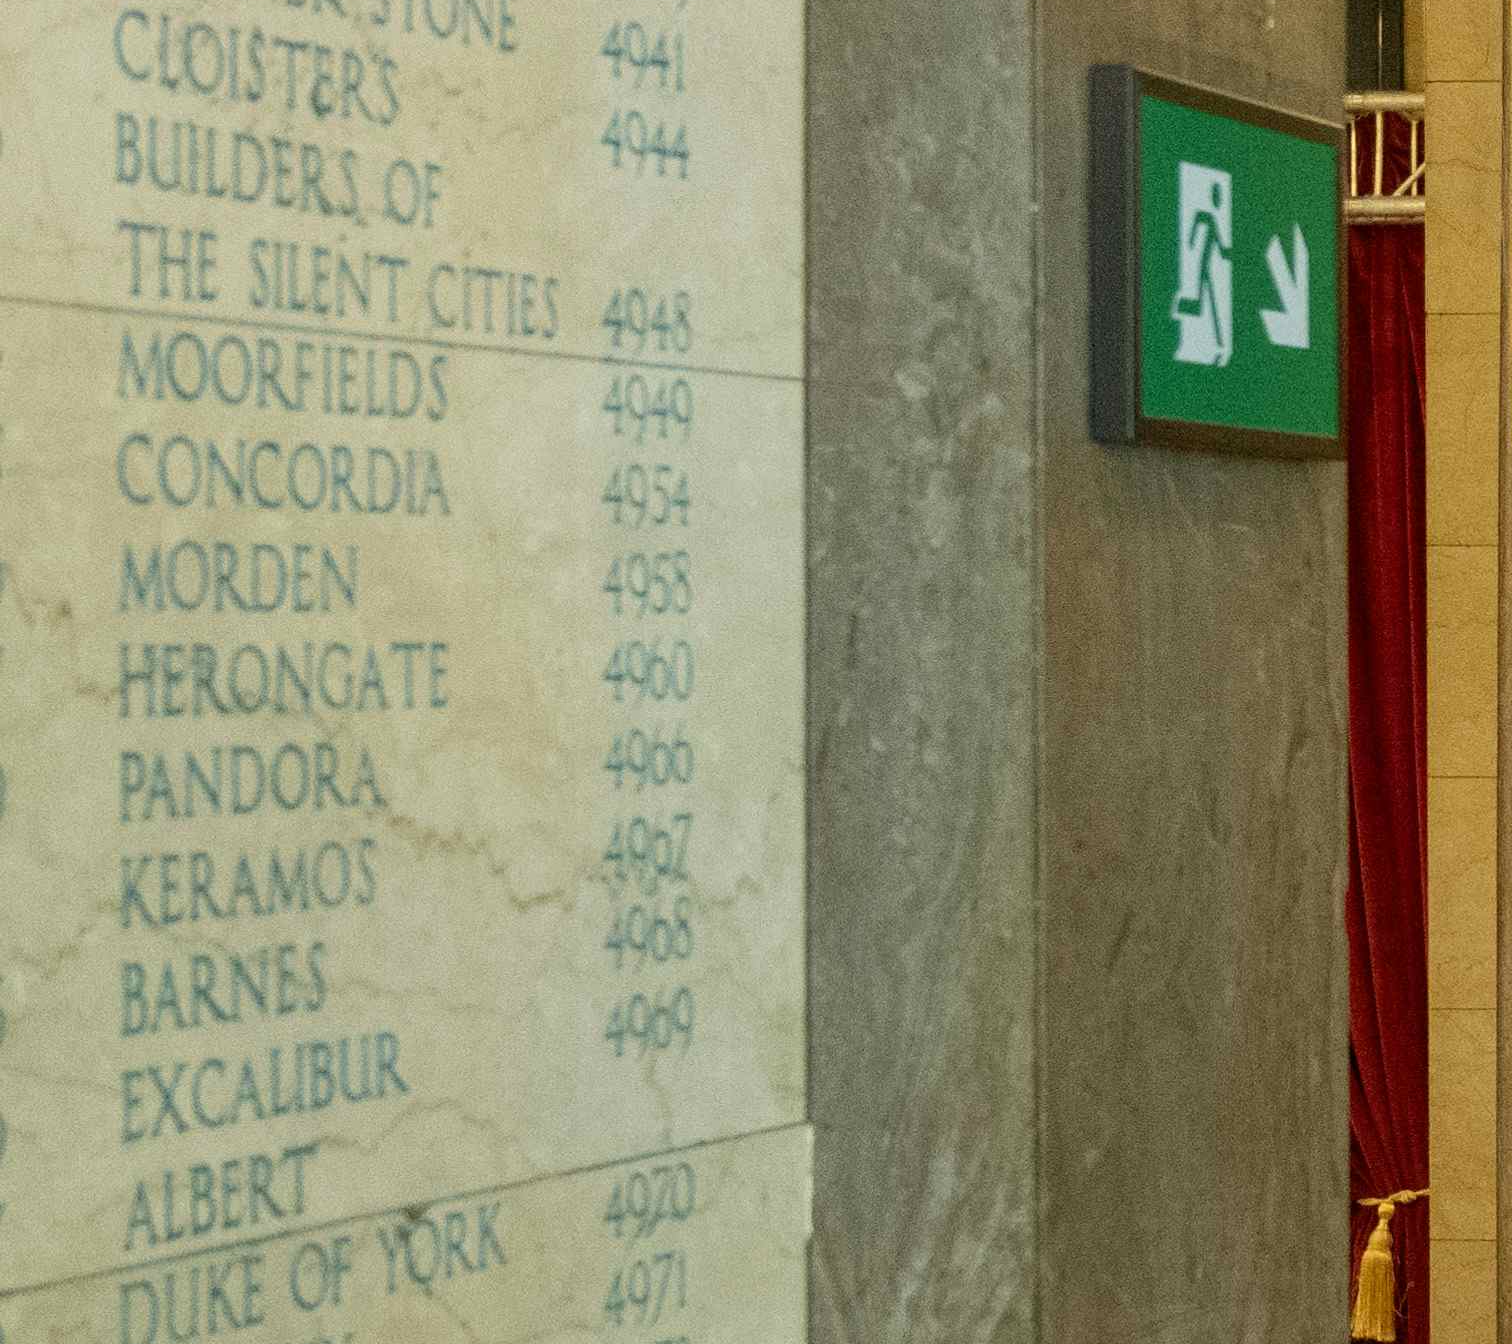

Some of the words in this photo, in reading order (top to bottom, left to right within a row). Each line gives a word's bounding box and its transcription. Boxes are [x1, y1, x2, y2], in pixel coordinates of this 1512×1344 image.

[114, 9, 402, 128] CLOISTERS
[600, 112, 691, 180] 4944
[600, 22, 687, 94] 4941
[115, 112, 359, 224] BUILDERS
[383, 158, 443, 228] OF
[117, 221, 219, 303] THE
[250, 238, 410, 322] SILENT
[428, 262, 562, 340] CITIES
[602, 288, 692, 354] 4948
[117, 328, 450, 424] MOORFIELDS
[602, 376, 694, 444] 4949
[115, 433, 452, 516] CONCORDIA
[602, 464, 692, 529] 4954
[117, 539, 359, 617] MORDEN
[117, 641, 450, 720] HERONGATE
[120, 742, 389, 824] PANDORA
[120, 838, 378, 929] KERAMOS
[120, 942, 328, 1039] BARNES
[120, 1030, 410, 1147] EXCALIBUR
[125, 1144, 319, 1252] ALBERT
[290, 1233, 355, 1314] OF
[377, 1202, 507, 1296] YORK
[603, 1253, 689, 1328] 4971
